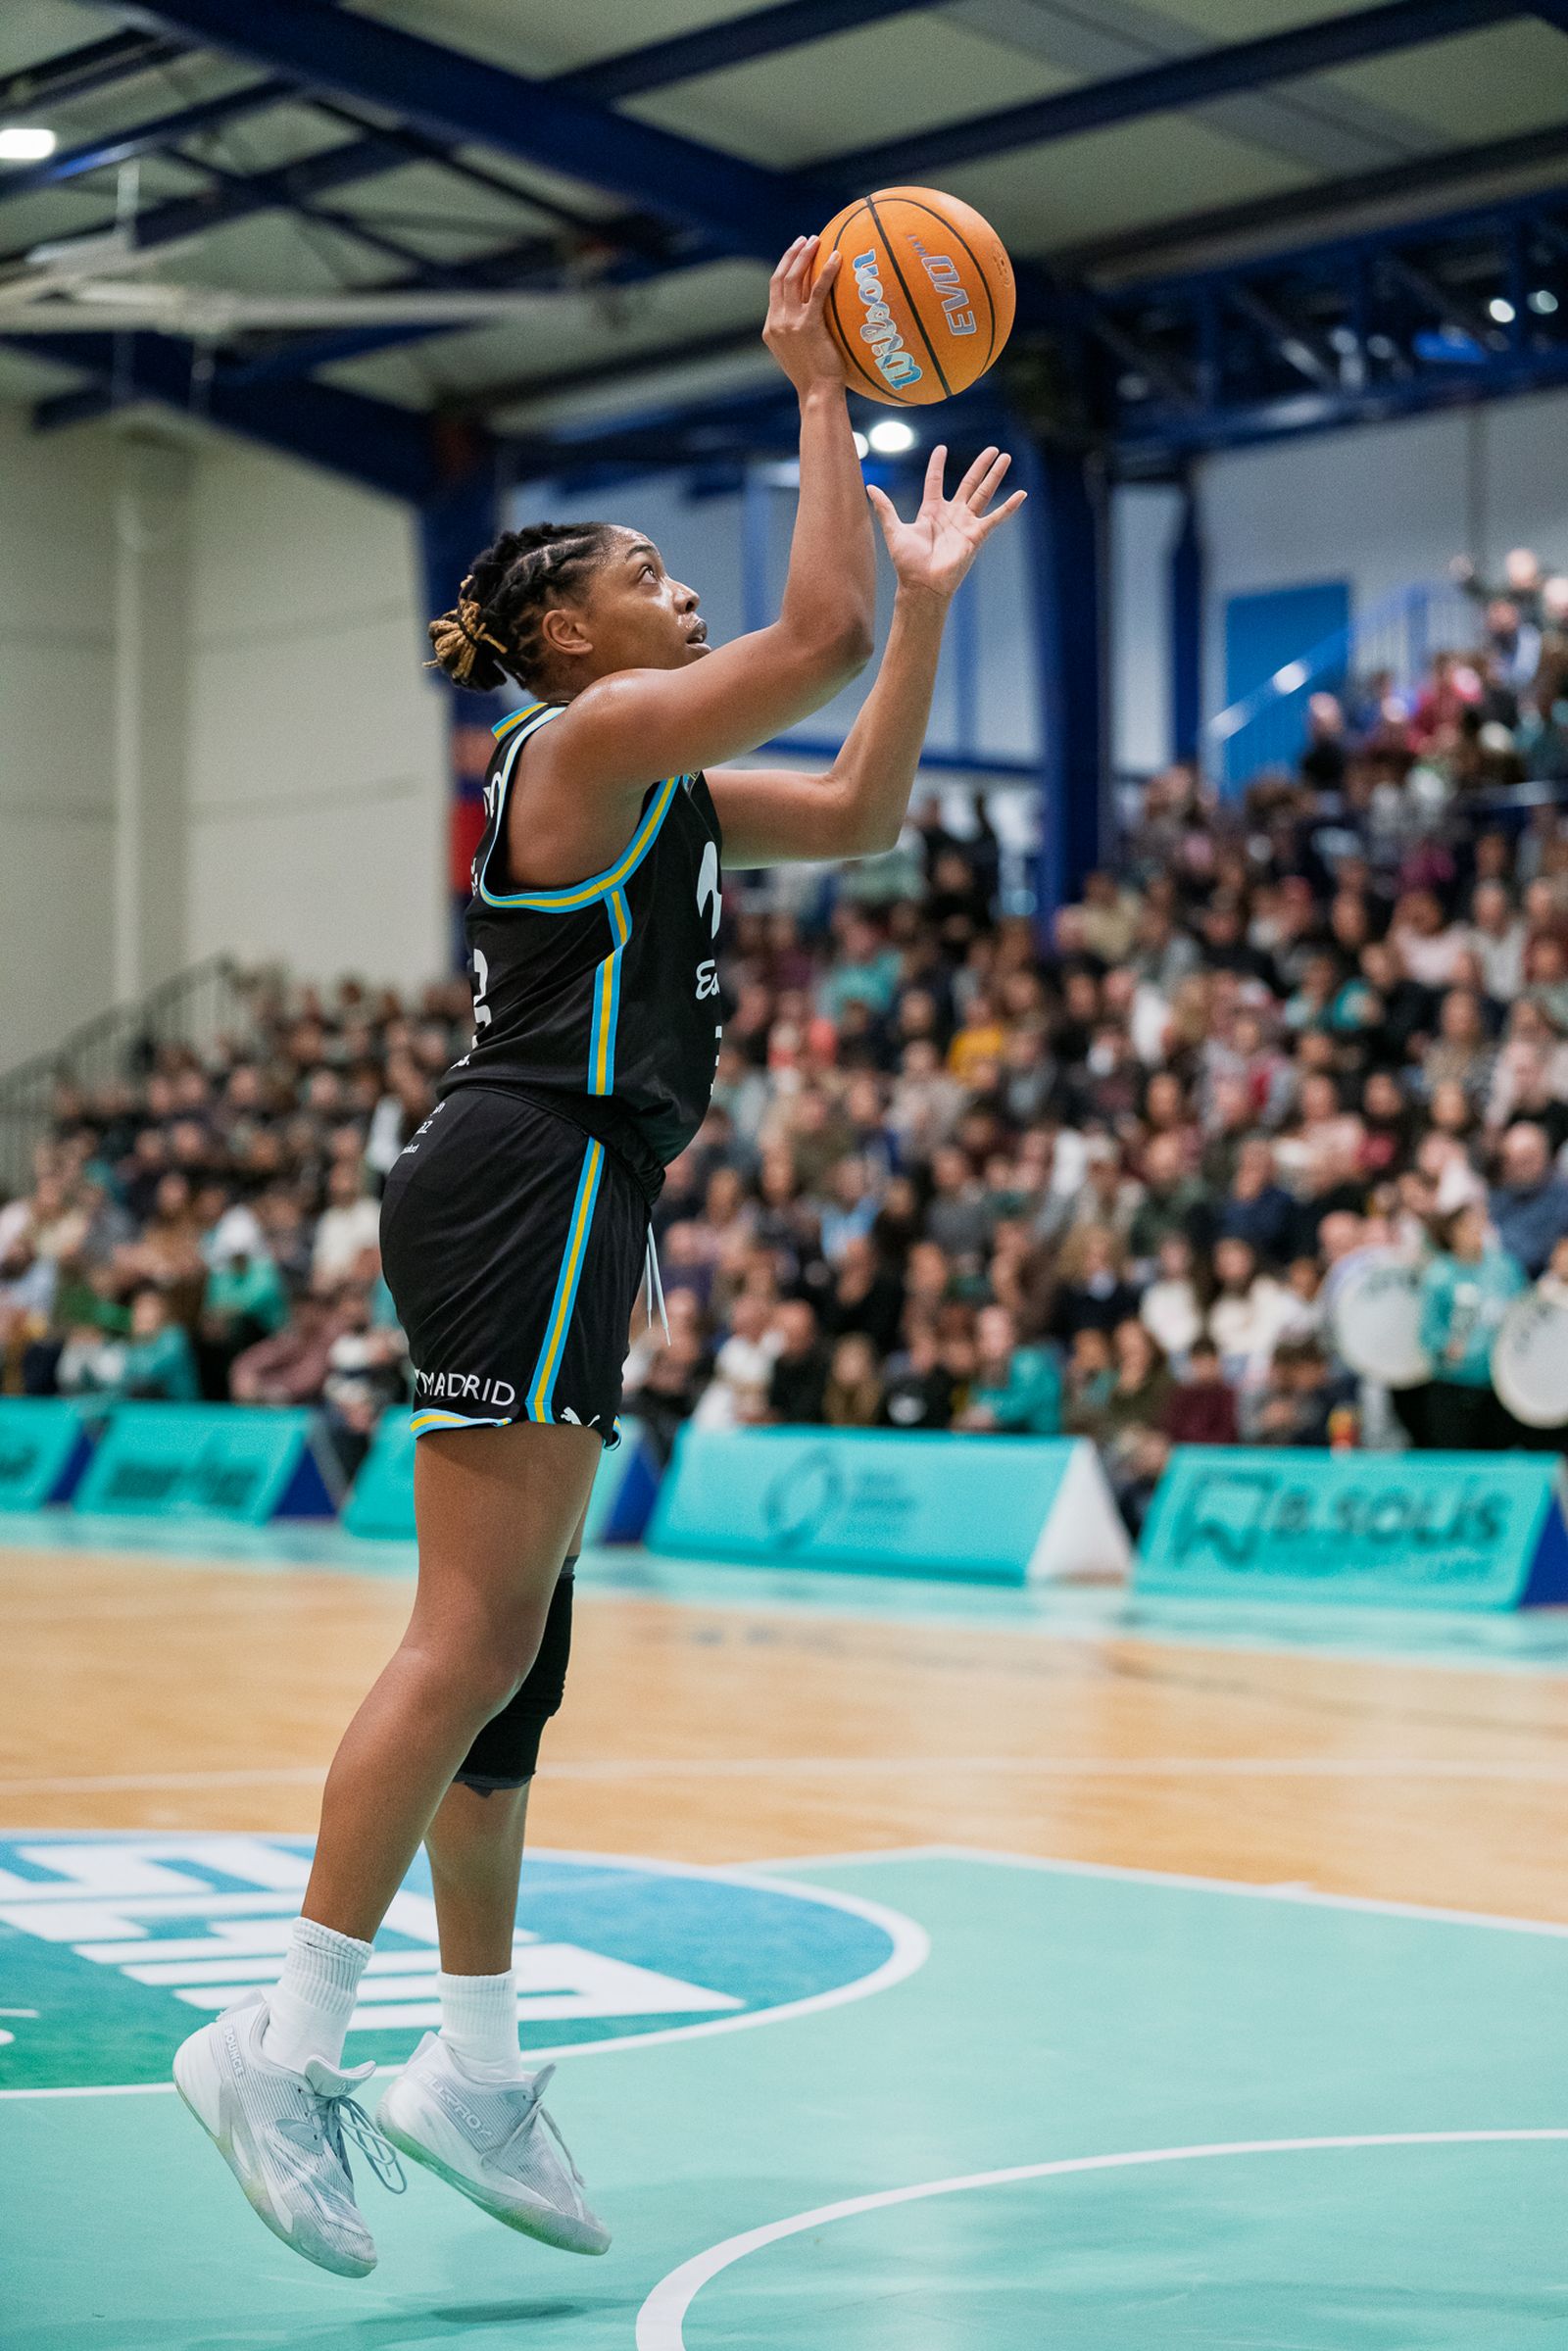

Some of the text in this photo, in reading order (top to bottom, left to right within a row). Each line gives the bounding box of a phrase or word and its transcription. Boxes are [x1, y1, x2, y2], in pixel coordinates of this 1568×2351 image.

[853, 248, 923, 390] Wilson
[921, 255, 977, 336] EVO
[419, 1371, 515, 1407] MADRID
[223, 2026, 247, 2080] BOUNCE
